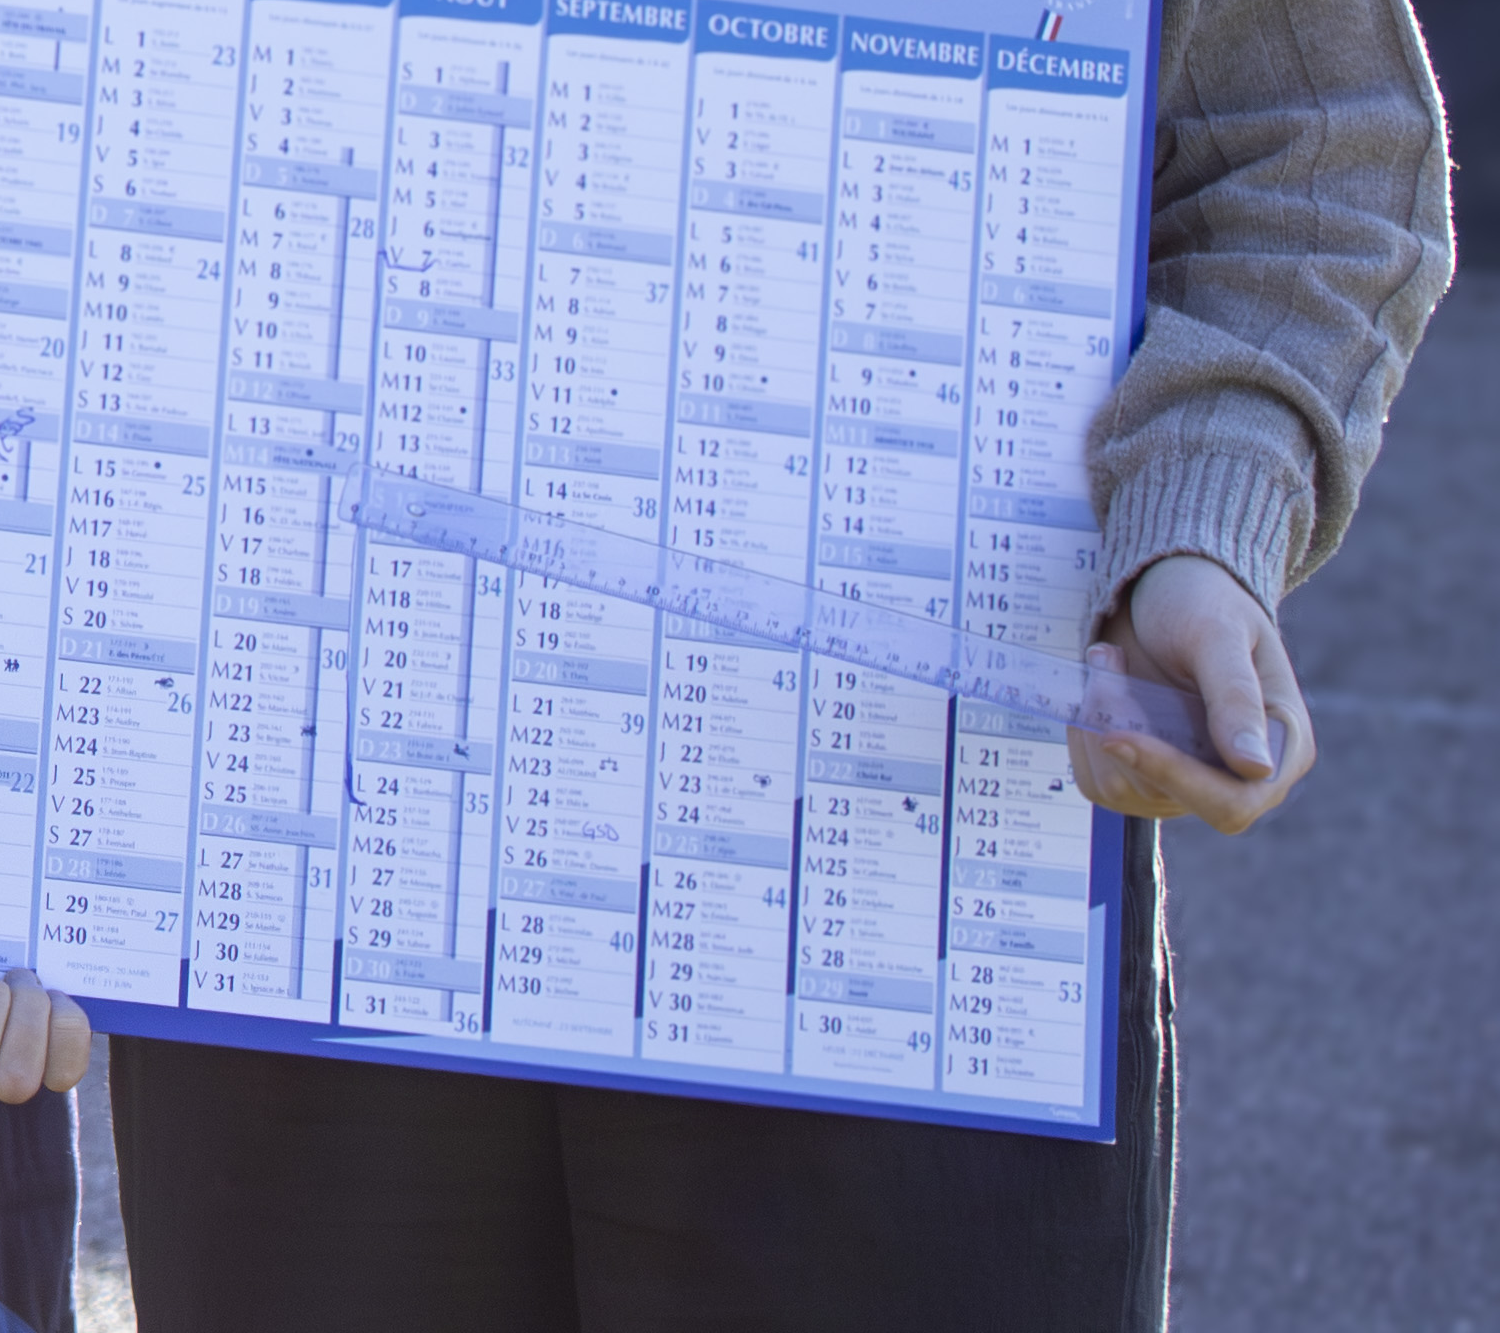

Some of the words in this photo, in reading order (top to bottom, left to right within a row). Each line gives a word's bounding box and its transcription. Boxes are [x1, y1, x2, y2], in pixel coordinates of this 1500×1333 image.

[708, 13, 829, 49] OCTOBRE
[851, 30, 980, 68] NOVEMBRE
[997, 47, 1126, 86] DÉCEMBRE
[948, 170, 971, 192] 45
[836, 269, 850, 287] V
[866, 273, 879, 292] 6
[529, 412, 540, 431] S
[551, 415, 573, 436] 12
[182, 475, 206, 497] 25
[220, 533, 234, 552] V
[241, 536, 264, 556] 17
[24, 552, 48, 576] 21
[66, 576, 80, 595] V
[87, 579, 109, 599] 19
[361, 708, 371, 725] S
[380, 710, 404, 730] 22
[621, 713, 645, 735] 39
[204, 781, 215, 801] S
[224, 784, 247, 804] 25
[659, 771, 673, 790] V
[679, 774, 702, 795] 23
[657, 802, 668, 821] S
[677, 804, 701, 825] 24
[48, 825, 60, 844] S
[69, 828, 93, 847] 27
[506, 815, 520, 834] V
[525, 817, 549, 838] 25
[954, 897, 963, 911] S
[974, 900, 996, 918] 26
[154, 910, 178, 933] 27
[1058, 982, 1082, 1003] 53
